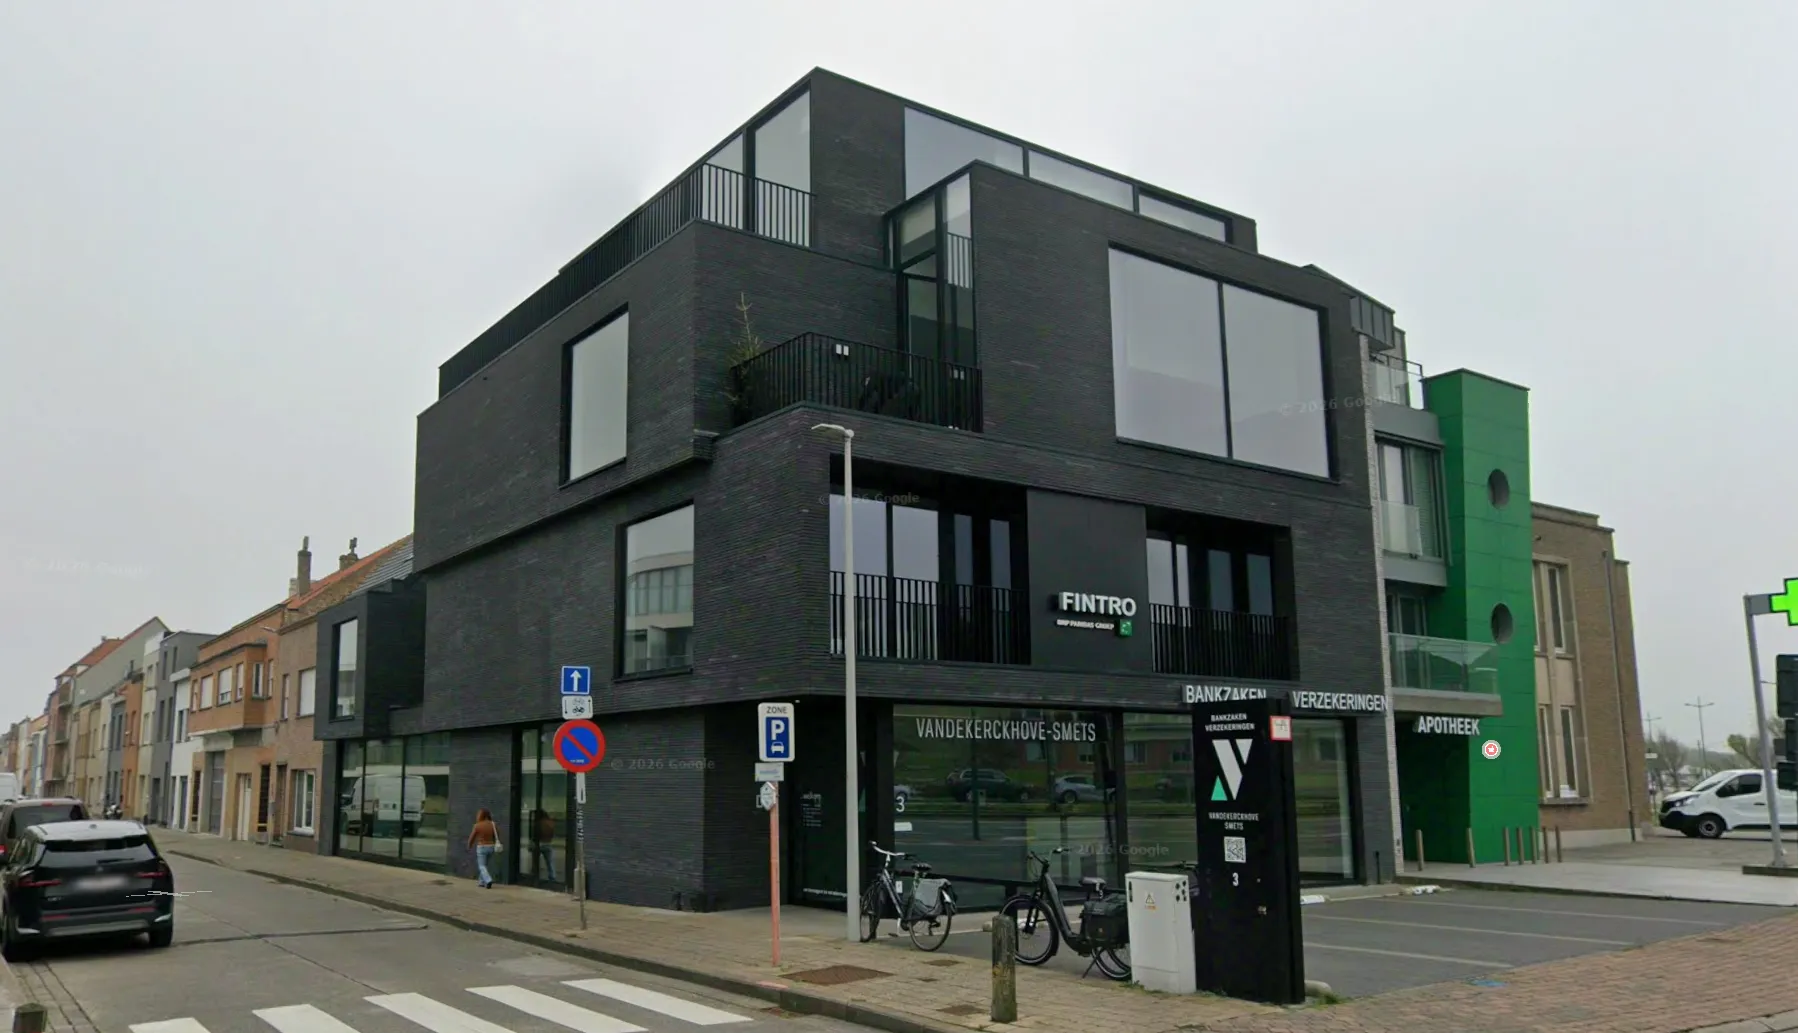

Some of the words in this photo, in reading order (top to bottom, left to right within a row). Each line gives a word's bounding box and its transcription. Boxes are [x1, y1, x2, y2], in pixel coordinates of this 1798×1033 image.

[1060, 591, 1137, 617] FINTRO
[1292, 690, 1388, 711] VERZEKERINGEN
[766, 705, 788, 714] ZONE
[1210, 713, 1248, 722] BANKZAKEN
[771, 719, 785, 741] P
[915, 718, 1097, 742] VANDEKERCKHOVE-SMETS
[1204, 722, 1255, 732] VERZEKERINGEN
[1417, 715, 1480, 736] APOTHEEK
[895, 796, 905, 813] 3
[1224, 821, 1245, 831] SMETS
[1232, 872, 1240, 887] 3
